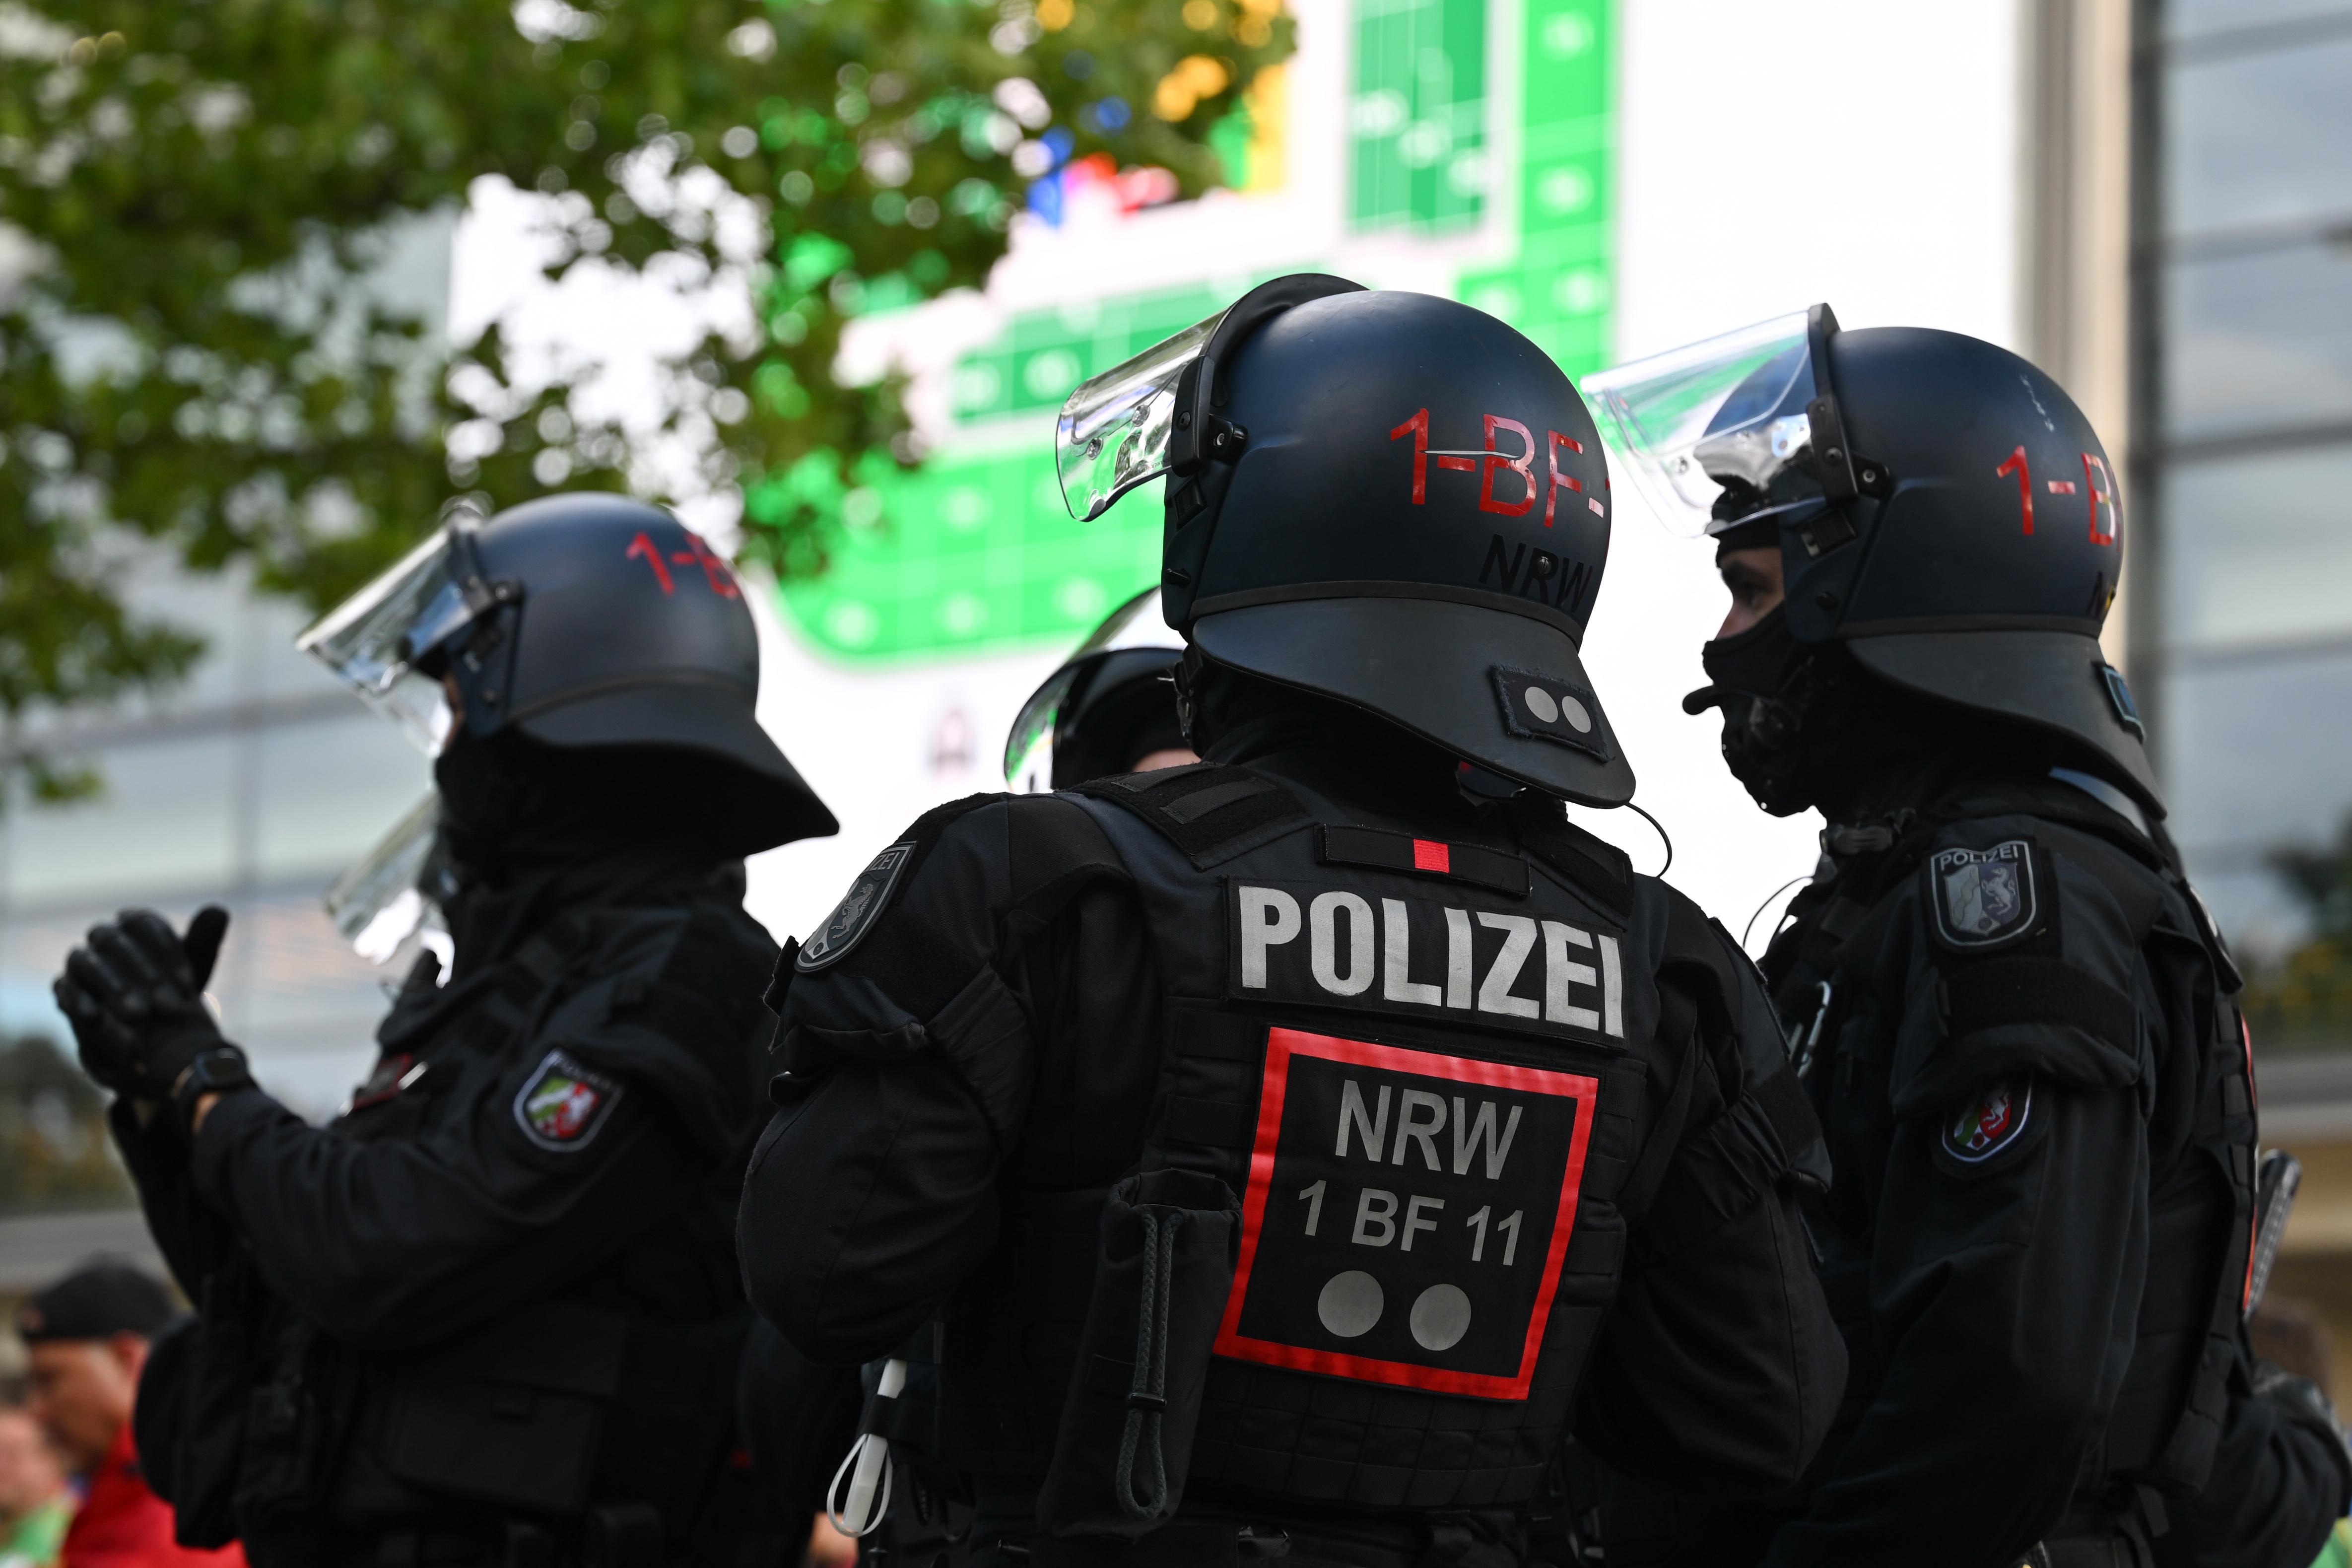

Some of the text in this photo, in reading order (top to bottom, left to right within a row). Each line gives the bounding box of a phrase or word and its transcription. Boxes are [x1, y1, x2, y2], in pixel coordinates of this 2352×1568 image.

[1391, 408, 1610, 529] 1-BF-
[1997, 445, 2121, 549] 1-B
[1478, 534, 1594, 613] NRW
[1941, 845, 2018, 871] POLIZEI
[1238, 886, 1624, 1039] POLIZEI
[1335, 1079, 1523, 1180] NRW
[1298, 1179, 1523, 1266] 1 BF 11
